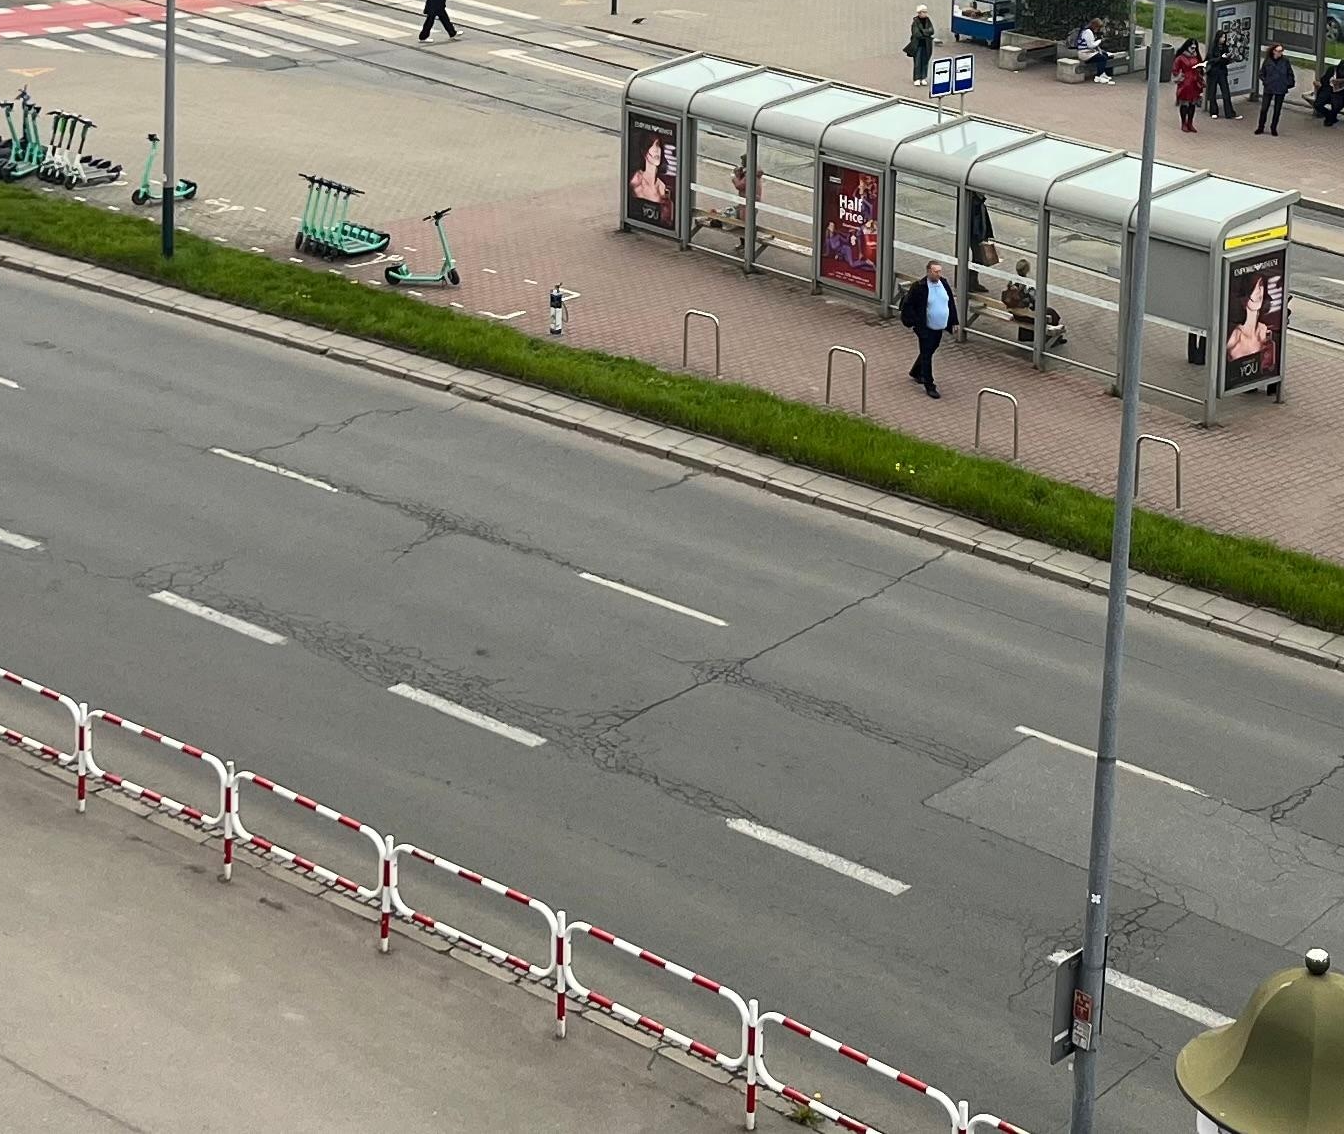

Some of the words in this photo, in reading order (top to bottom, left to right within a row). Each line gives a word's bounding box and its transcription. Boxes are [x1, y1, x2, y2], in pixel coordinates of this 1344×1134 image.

[839, 194, 863, 213] Half
[839, 207, 864, 225] Price
[1239, 361, 1258, 378] YOU
